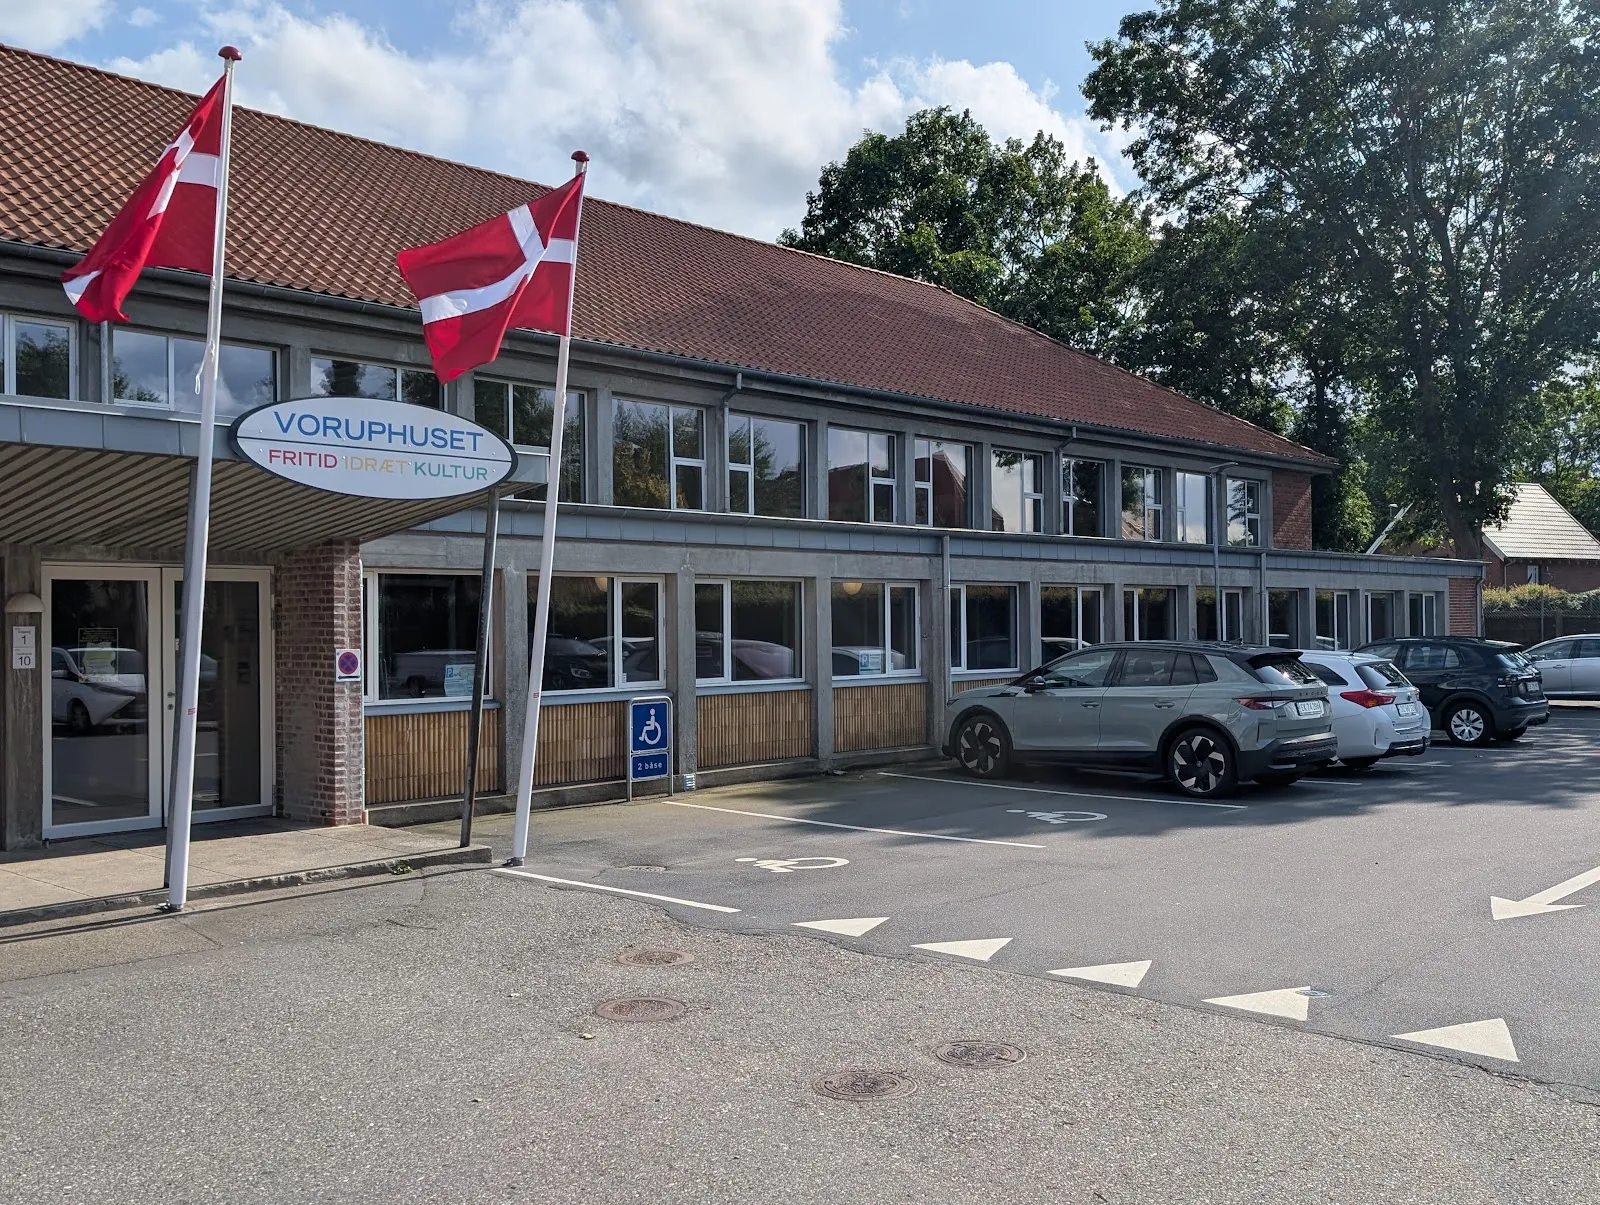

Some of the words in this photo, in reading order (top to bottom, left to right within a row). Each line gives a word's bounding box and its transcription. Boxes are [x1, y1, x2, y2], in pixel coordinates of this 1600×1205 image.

[274, 411, 483, 451] VORUPHUSET
[268, 448, 338, 469] FRITID
[345, 455, 409, 474] IDRÆT
[414, 461, 488, 481] KULTUR
[21, 635, 26, 645] 1
[18, 656, 31, 666] 10
[637, 762, 643, 771] 2
[644, 761, 663, 770] båse
